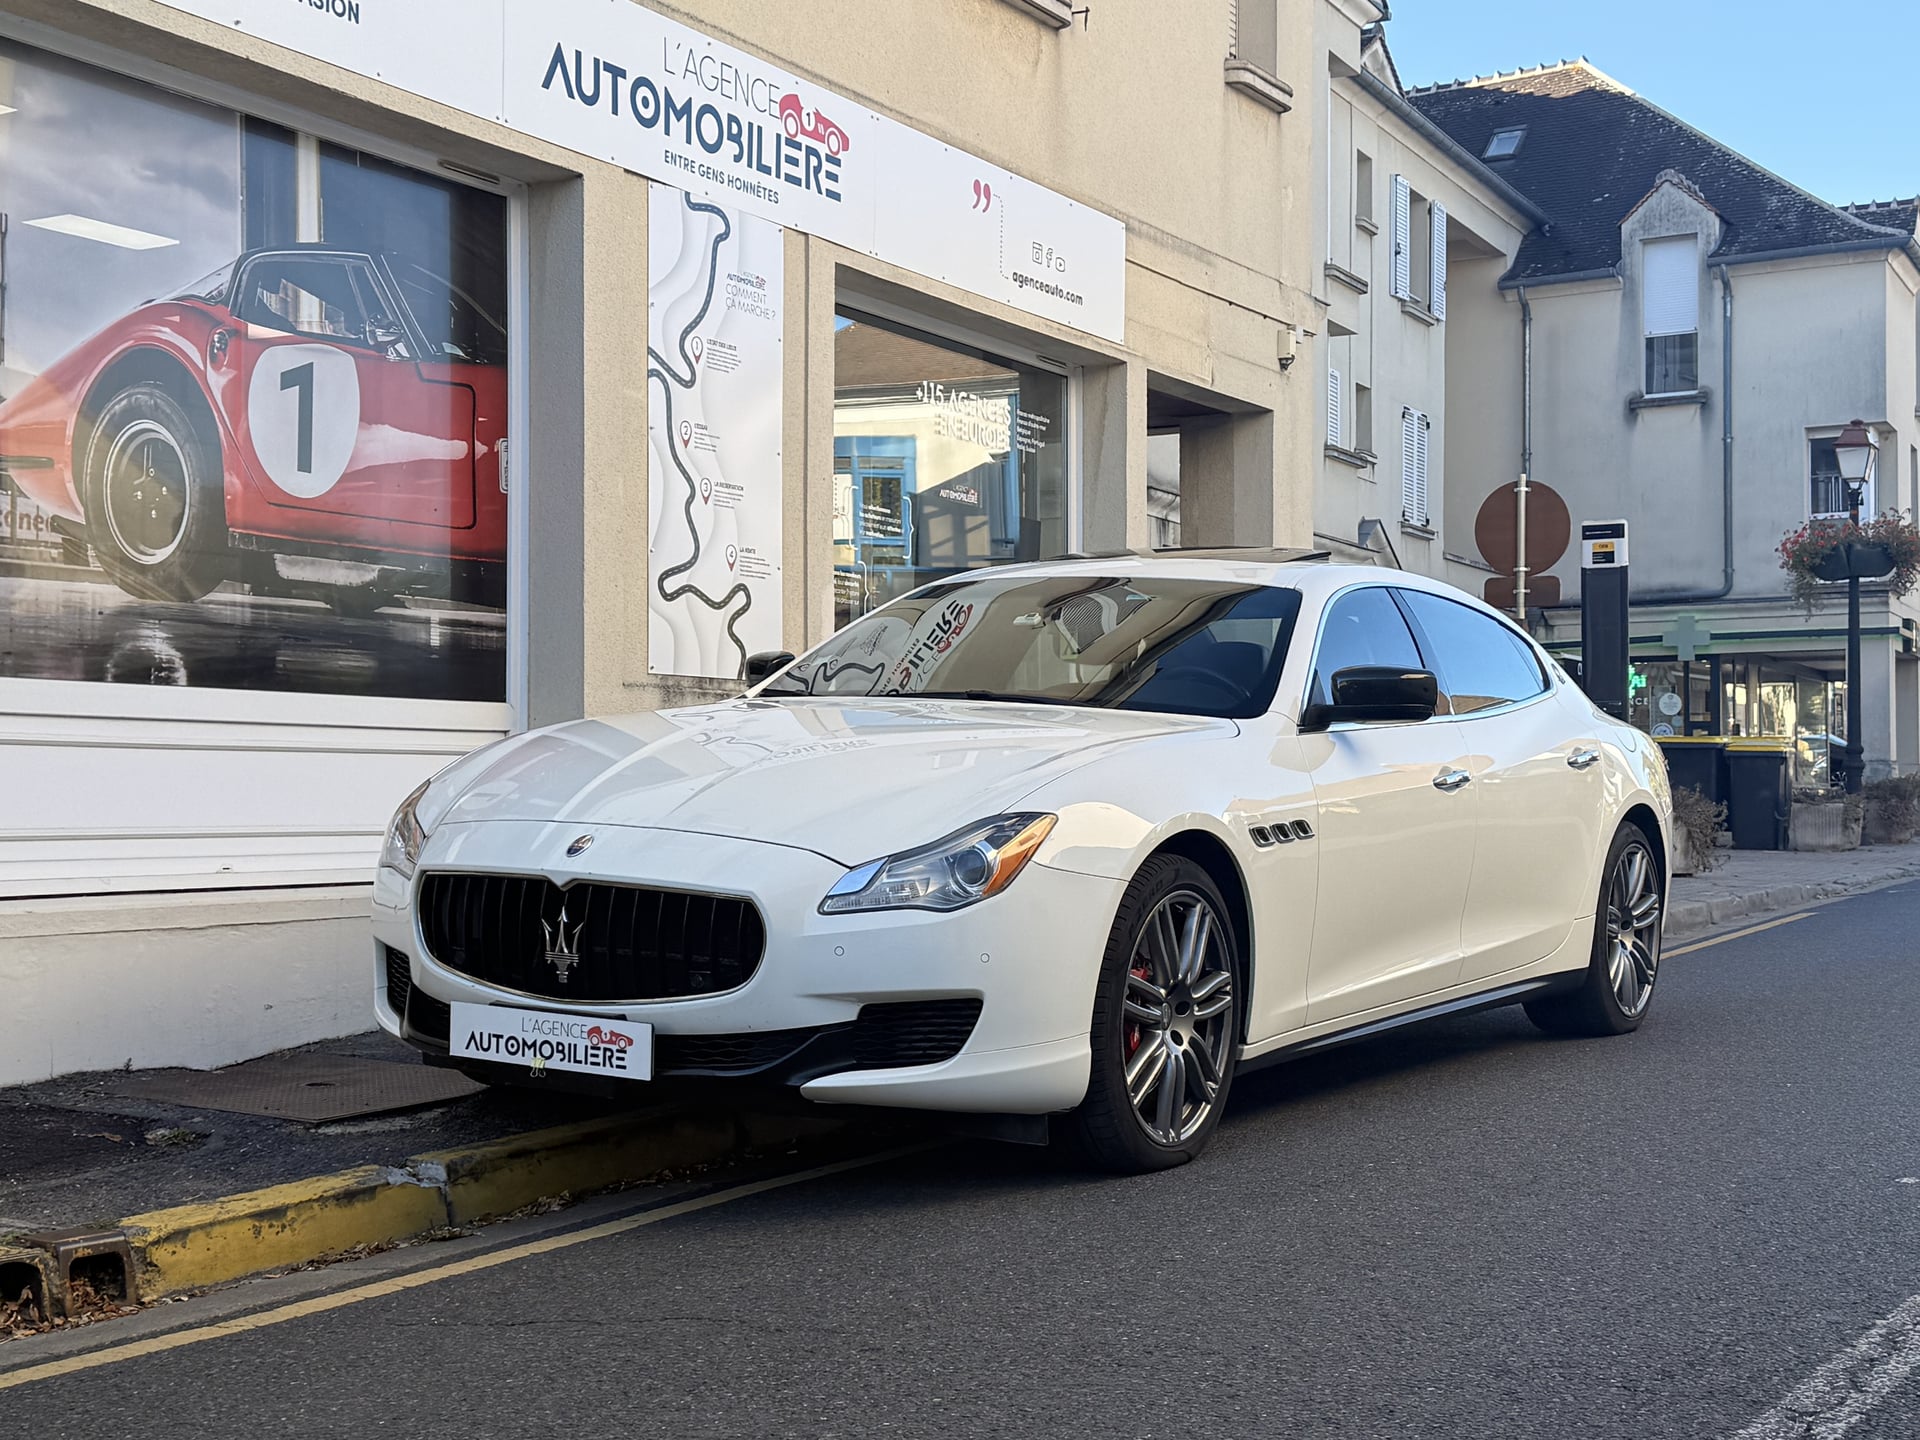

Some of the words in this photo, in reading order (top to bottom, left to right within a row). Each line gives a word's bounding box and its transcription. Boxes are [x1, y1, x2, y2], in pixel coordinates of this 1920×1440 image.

[664, 36, 781, 119] L'AGENCE
[664, 149, 696, 174] ENTRE
[698, 163, 725, 185] GENS
[727, 174, 779, 205] HONNÊTES
[726, 284, 767, 305] COMMENT
[1012, 271, 1083, 306] agenceauto.com
[738, 300, 770, 320] MARCHE
[280, 362, 314, 474] 1
[916, 381, 945, 406] +115
[949, 388, 1012, 426] AGENCES
[521, 1016, 588, 1040] L'AGENCE
[465, 1030, 628, 1070] AUTOMOBILIERE
